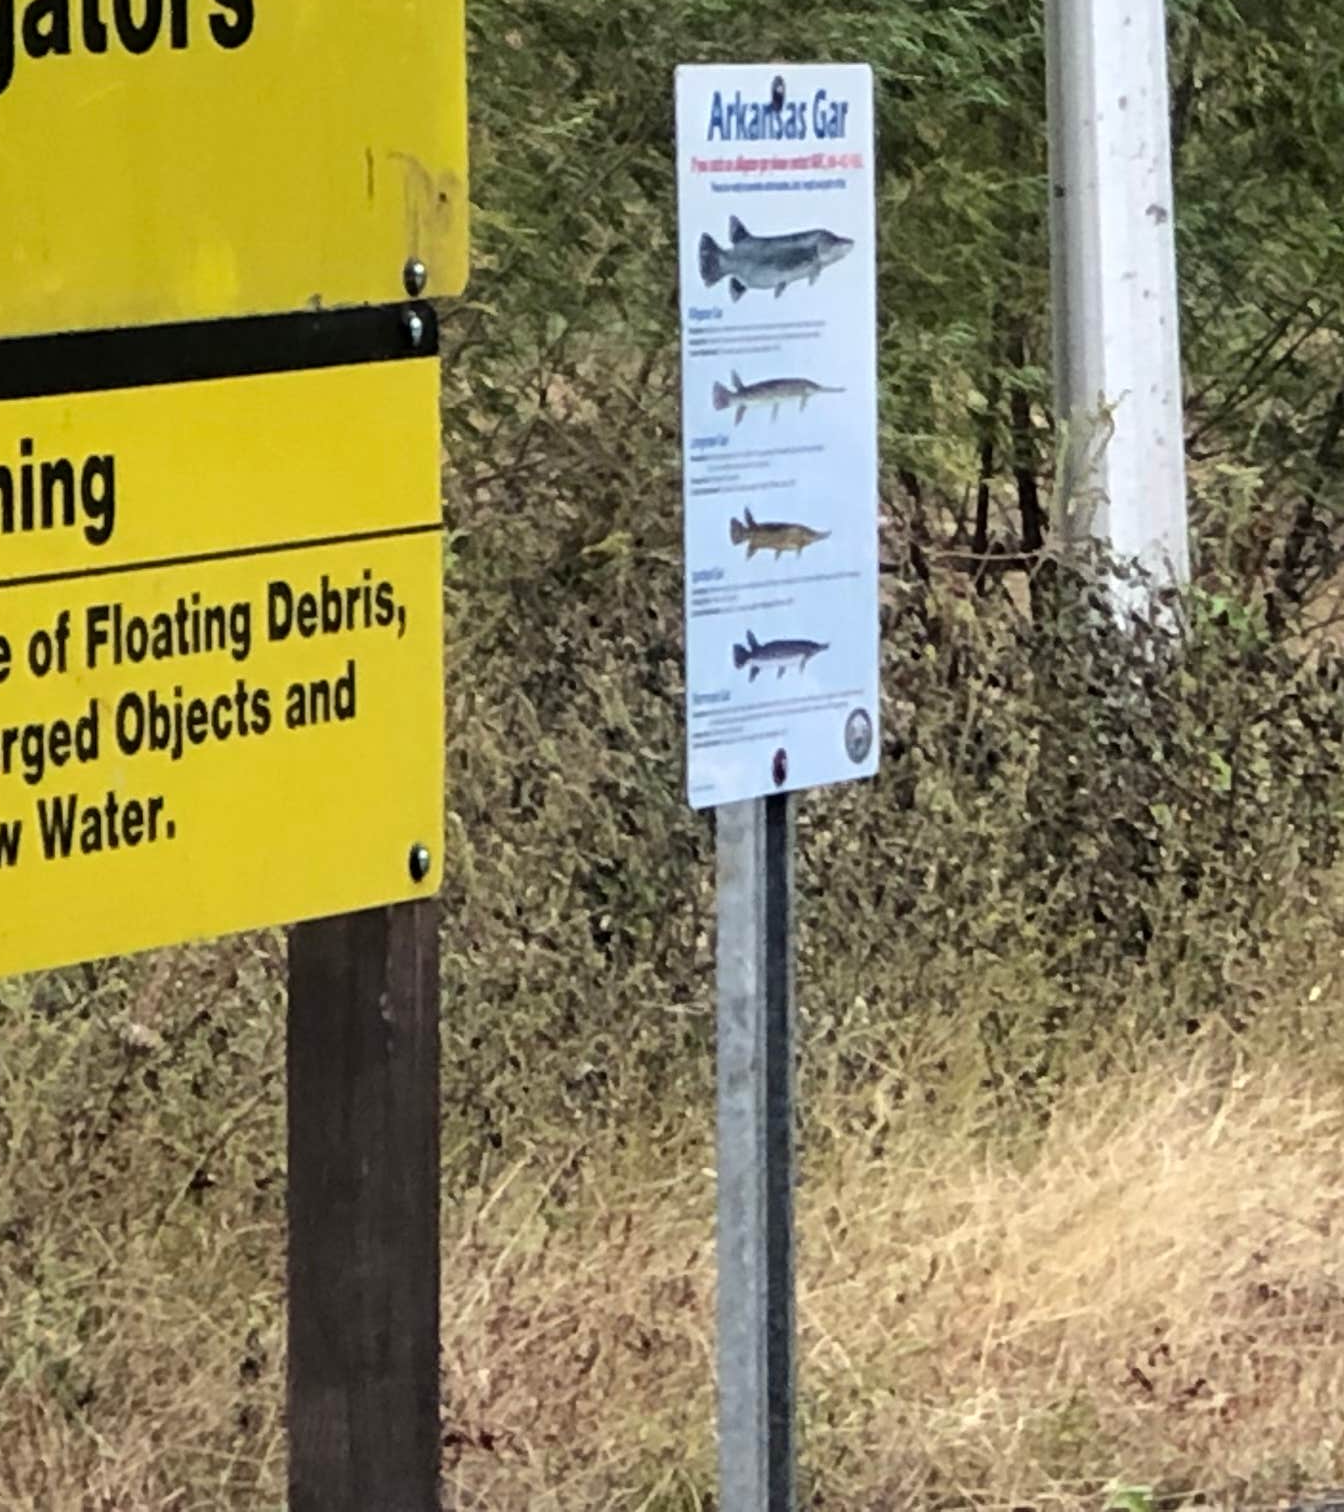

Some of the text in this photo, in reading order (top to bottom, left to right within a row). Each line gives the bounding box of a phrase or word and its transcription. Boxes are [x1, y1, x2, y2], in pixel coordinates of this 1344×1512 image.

[706, 89, 849, 141] Arkansas Gar
[29, 610, 70, 677] of
[87, 593, 251, 669] Floating
[268, 569, 405, 641] Debris,
[116, 680, 271, 760] Objects
[286, 660, 355, 729] and
[37, 791, 175, 859] Water.
